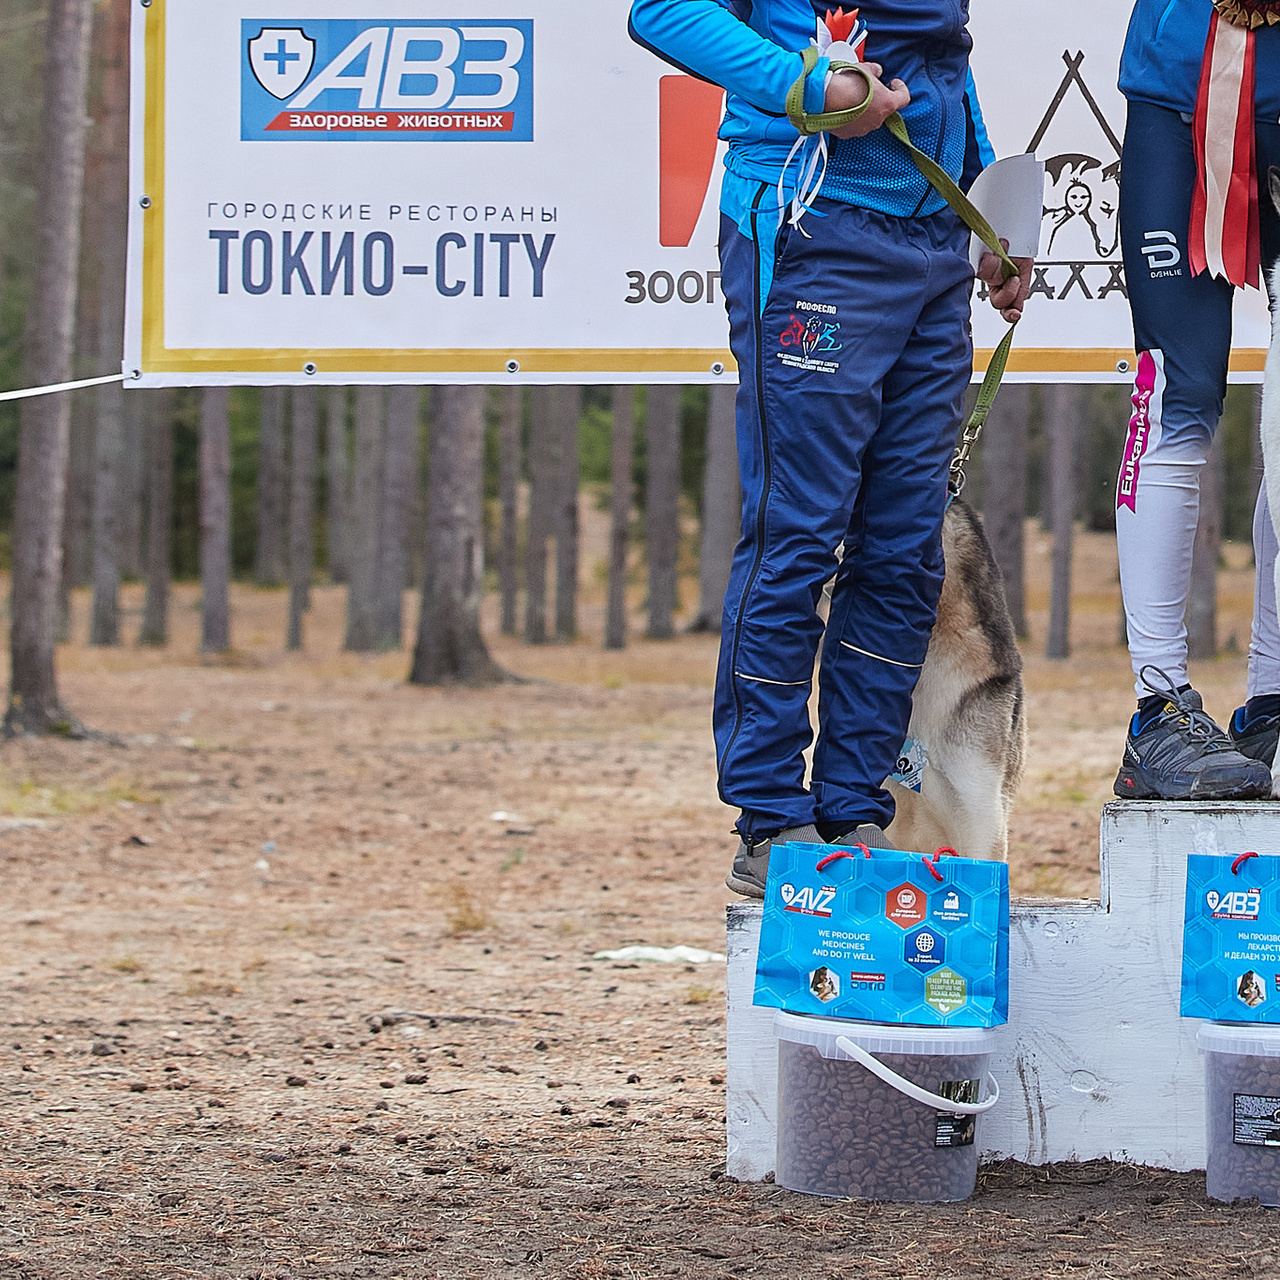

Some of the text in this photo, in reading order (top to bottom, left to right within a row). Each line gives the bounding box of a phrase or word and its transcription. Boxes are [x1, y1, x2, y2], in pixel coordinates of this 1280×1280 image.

[285, 26, 524, 109] АВЗ
[290, 114, 503, 130] здоровье животных
[207, 203, 558, 223] ГОРОДСКИЕ РЕСТОРАНЫ
[209, 230, 556, 297] ТОКИО-CITY
[788, 887, 836, 912] AVZ
[1214, 892, 1260, 915] АВЗ
[818, 929, 870, 941] WE PRODUCE
[822, 940, 865, 950] MEDICINES
[812, 948, 876, 961] AND DO IT WELL
[1224, 951, 1230, 959] И
[1261, 953, 1276, 962] ЭТО
